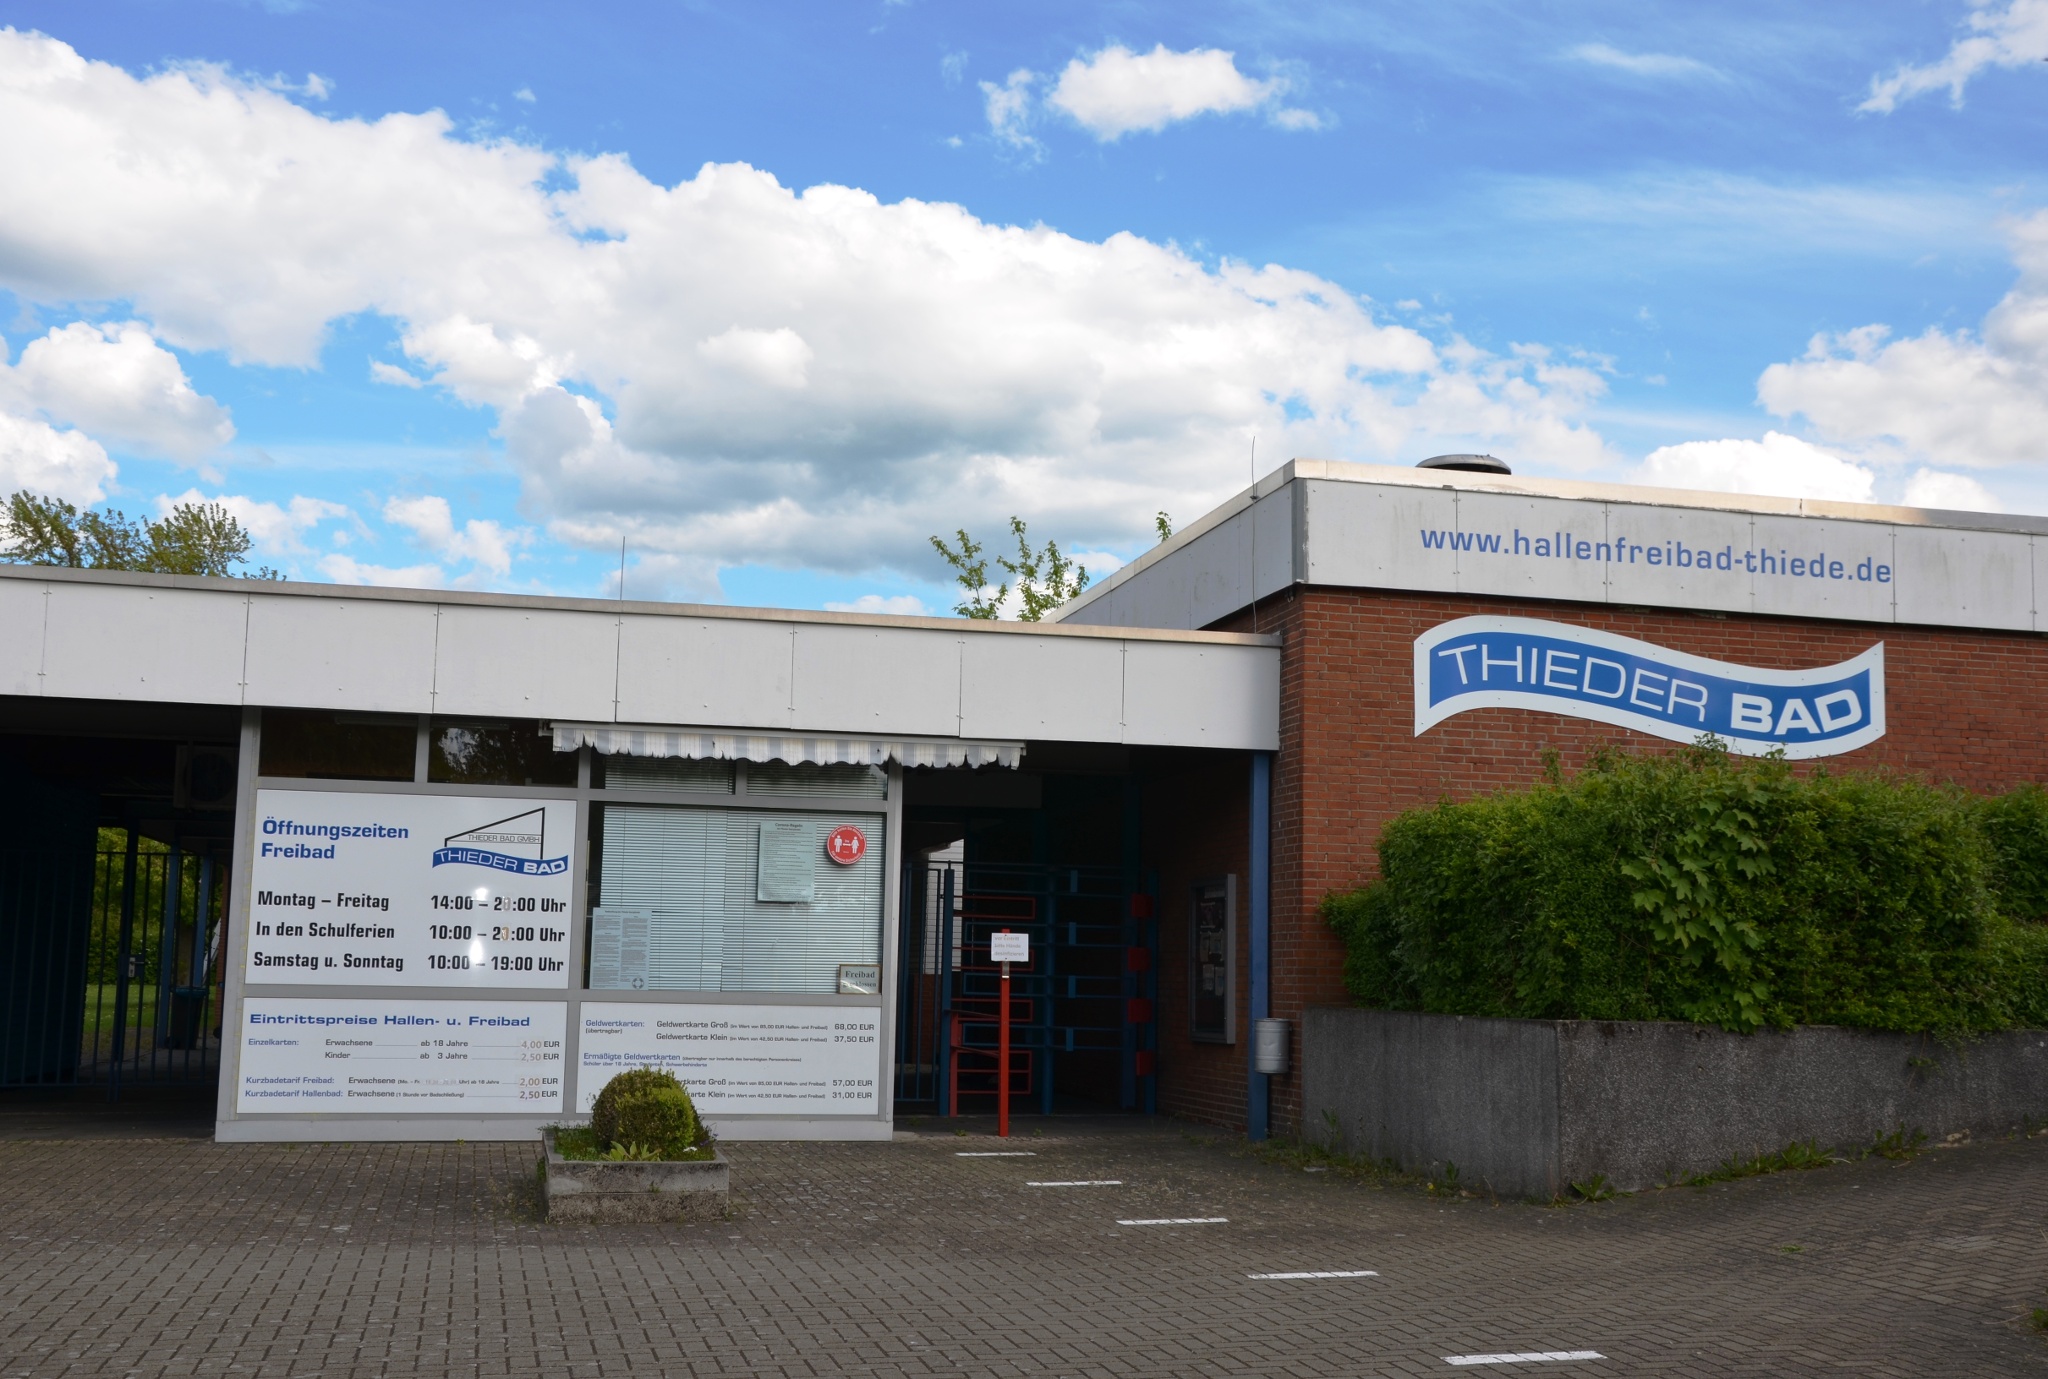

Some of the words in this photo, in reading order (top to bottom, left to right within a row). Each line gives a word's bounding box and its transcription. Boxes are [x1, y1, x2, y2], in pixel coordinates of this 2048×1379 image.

[1421, 528, 1892, 584] www.hallenfreibad-thiede.de
[1438, 643, 1709, 723] THIEDER
[1731, 689, 1862, 736] BAD
[262, 816, 409, 841] Öffnungszeiten
[468, 834, 498, 842] THIEDER
[261, 842, 335, 859] Freibad
[435, 850, 518, 871] THIEDER
[523, 860, 566, 874] BAD
[258, 890, 316, 910] Montag
[337, 892, 390, 912] Freitag
[430, 895, 473, 910] 14:00
[540, 897, 567, 912] Uhr
[256, 921, 270, 936] In
[276, 921, 303, 936] den
[308, 922, 395, 938] Schulferien
[429, 925, 472, 940] 10:00
[539, 927, 566, 942] Uhr
[254, 951, 319, 970] Samstag
[324, 956, 338, 968] u.
[343, 953, 404, 972] Sonntag
[427, 955, 470, 970] 10:00
[491, 956, 533, 971] 19:00
[538, 957, 564, 972] Uhr
[845, 970, 876, 978] Freibad
[250, 1014, 378, 1026] Eintrittspreise
[384, 1016, 440, 1026] Hallen-
[446, 1018, 461, 1026] u.
[468, 1016, 530, 1027] Freibad
[586, 1020, 645, 1028] Geldwertkarten:
[656, 1020, 708, 1028] Geldwertkarte
[710, 1021, 729, 1029] Groß
[834, 1024, 857, 1032] 68,00
[248, 1038, 299, 1046] Einzelkarten:
[521, 1040, 542, 1050] 4,00
[656, 1032, 708, 1040] Geldwertkarte
[834, 1036, 857, 1044] 37,50
[583, 1052, 622, 1061] Ermäßigte
[624, 1053, 680, 1061] Geldwertkarten
[520, 1078, 540, 1088] 2,00
[708, 1078, 726, 1086] Groß
[348, 1090, 395, 1098] Erwachsene
[519, 1091, 540, 1100] 2,50
